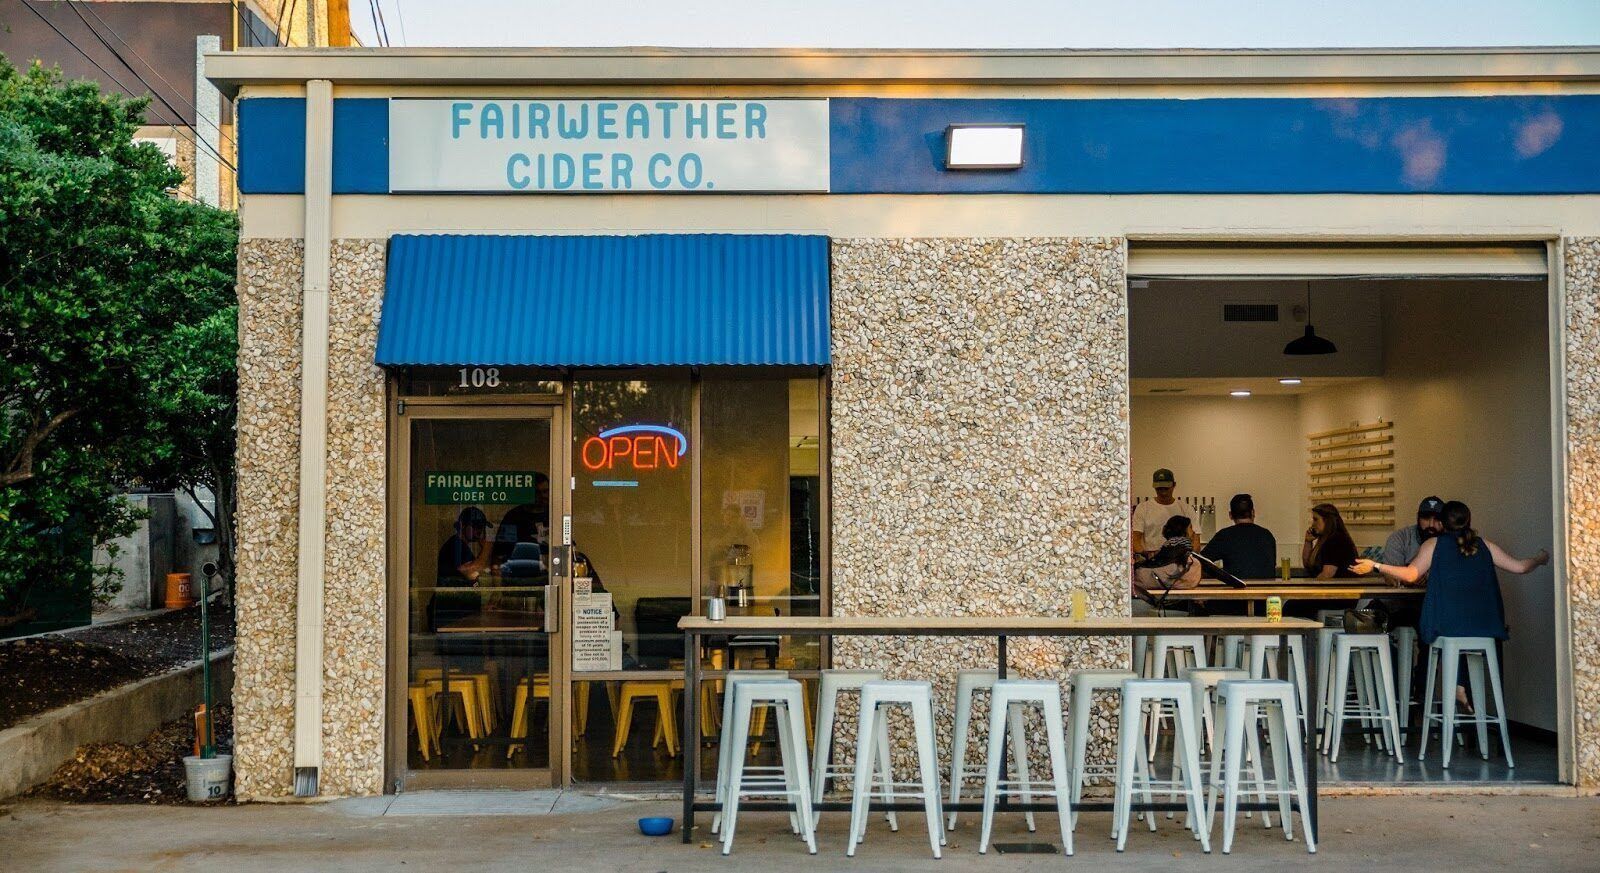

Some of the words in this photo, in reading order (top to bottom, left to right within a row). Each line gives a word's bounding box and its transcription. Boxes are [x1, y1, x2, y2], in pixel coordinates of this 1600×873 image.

[452, 102, 767, 140] FAIRWEATHER
[506, 153, 633, 190] CIDER
[648, 153, 714, 190] CO.
[458, 367, 500, 388] 108
[582, 436, 679, 470] OPEN
[428, 474, 533, 488] FAIRWEATHER
[452, 491, 485, 501] CIDER
[208, 785, 221, 795] 10
